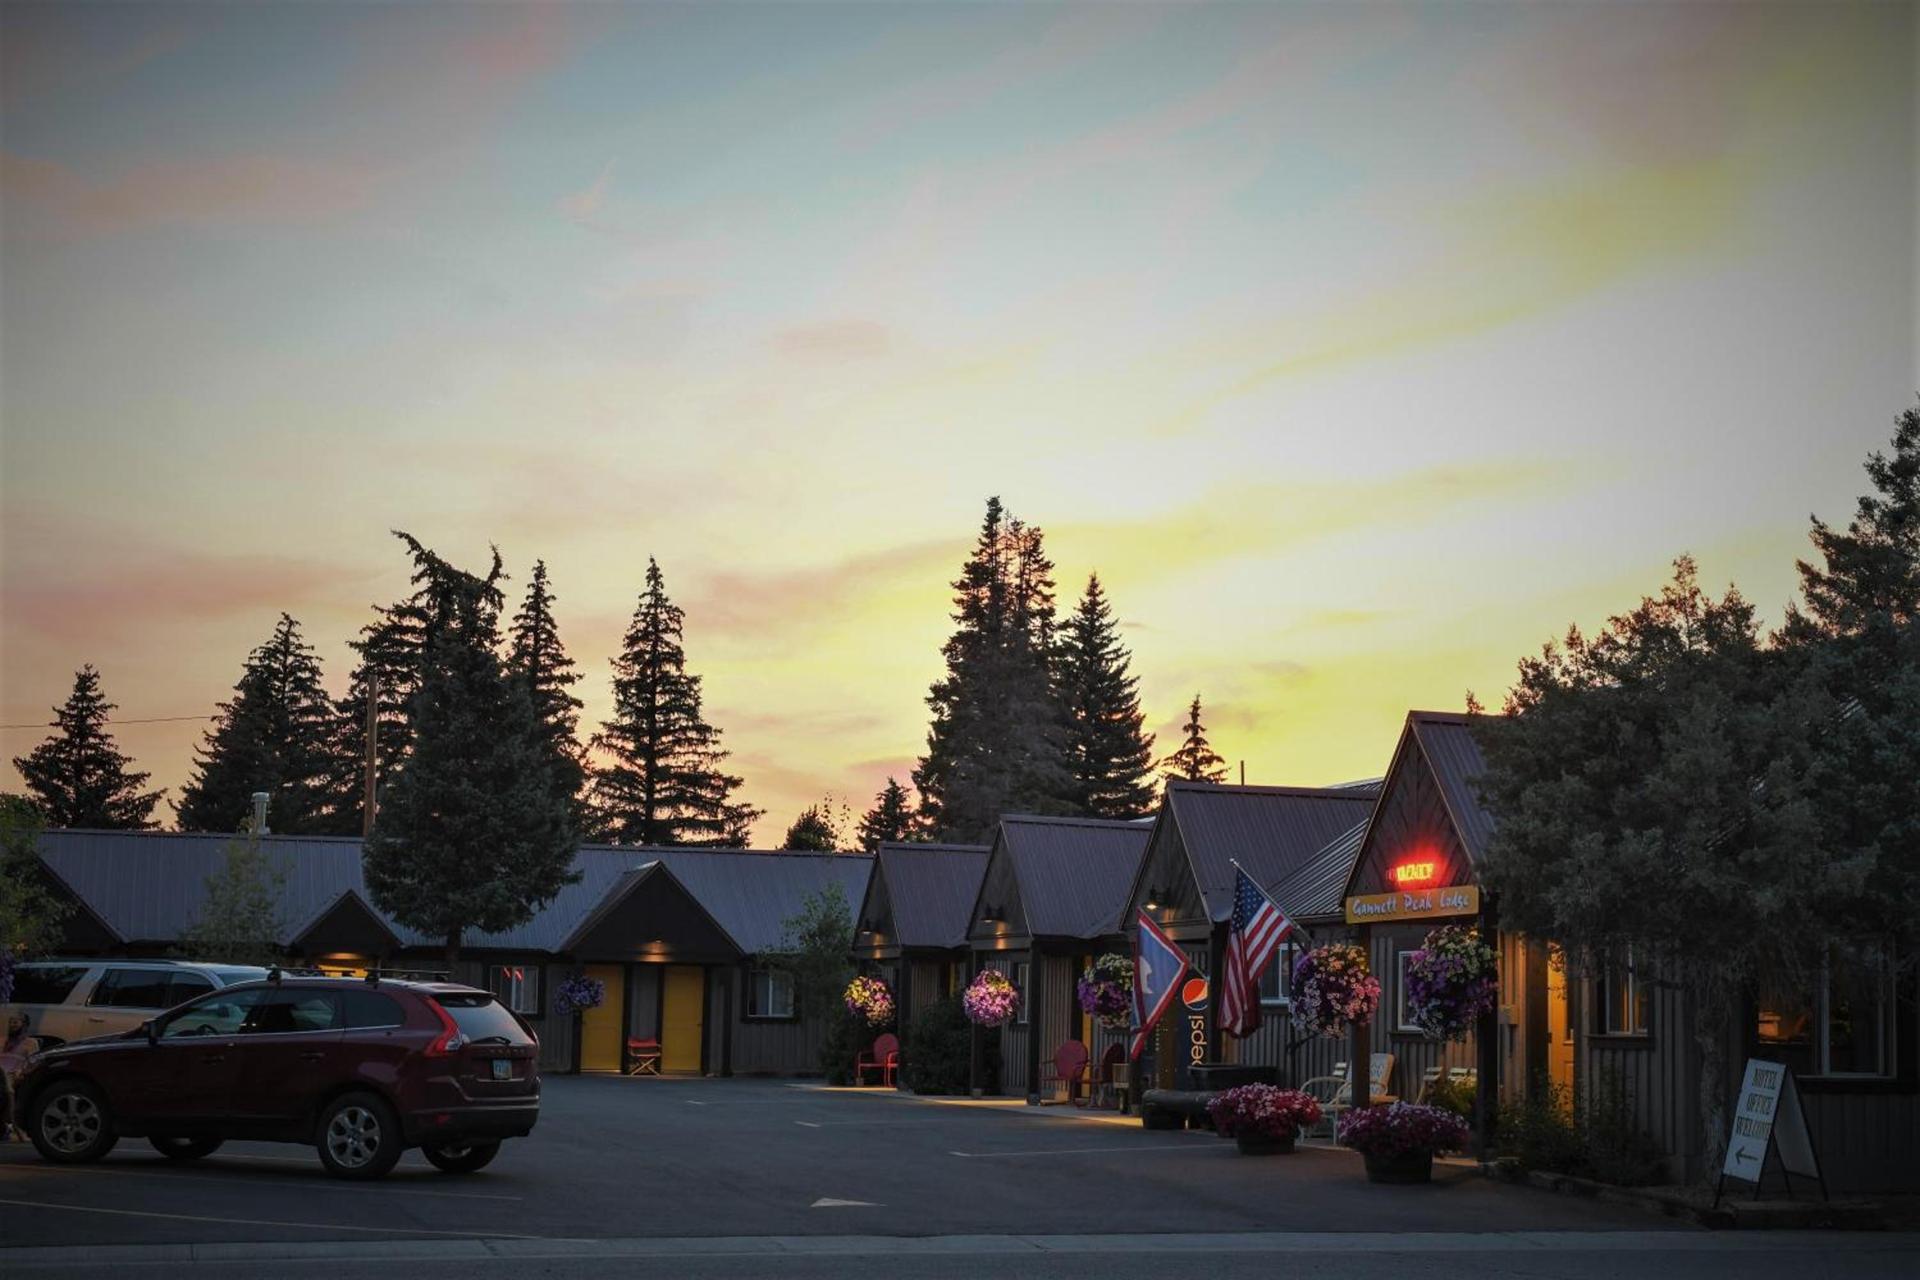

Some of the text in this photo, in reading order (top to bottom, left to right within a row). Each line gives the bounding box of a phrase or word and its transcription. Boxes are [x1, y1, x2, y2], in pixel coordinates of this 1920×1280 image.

[1353, 890, 1470, 916] Gannett Peak Lodge
